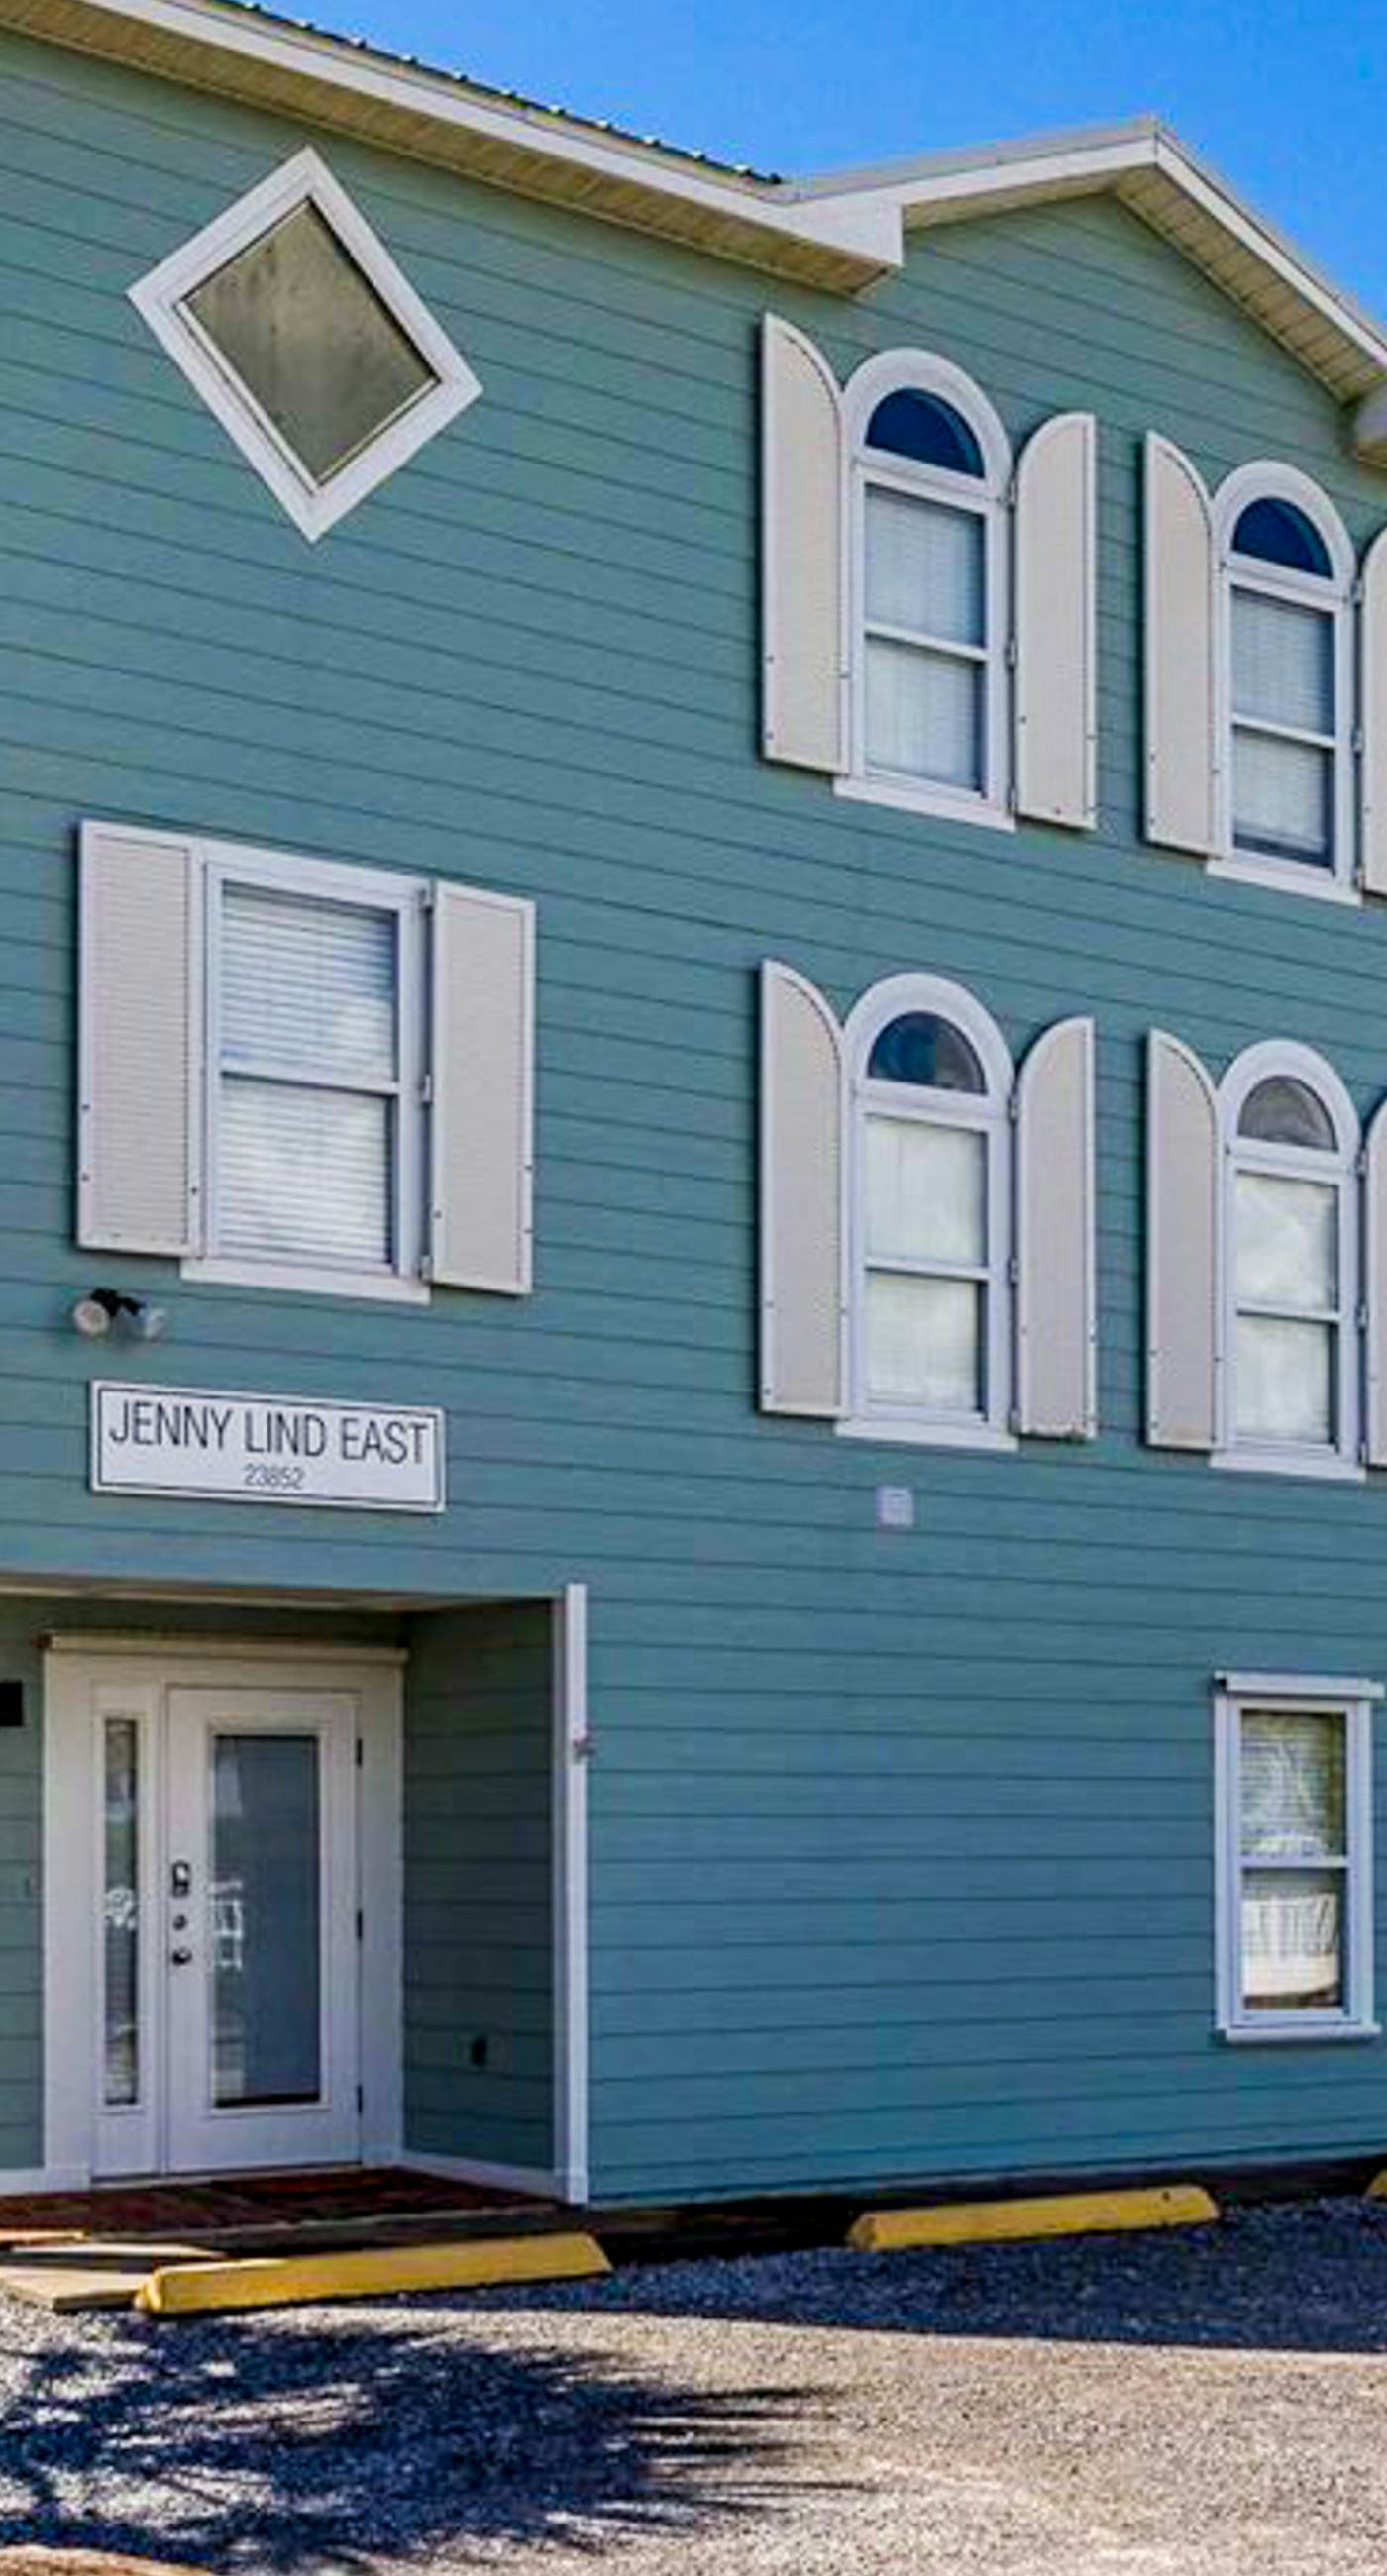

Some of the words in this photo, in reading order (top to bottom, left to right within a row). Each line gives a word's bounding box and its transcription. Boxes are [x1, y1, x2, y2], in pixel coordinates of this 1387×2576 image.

[109, 1400, 232, 1449] JENNY
[244, 1411, 326, 1458] LIND
[341, 1417, 428, 1464] EAST
